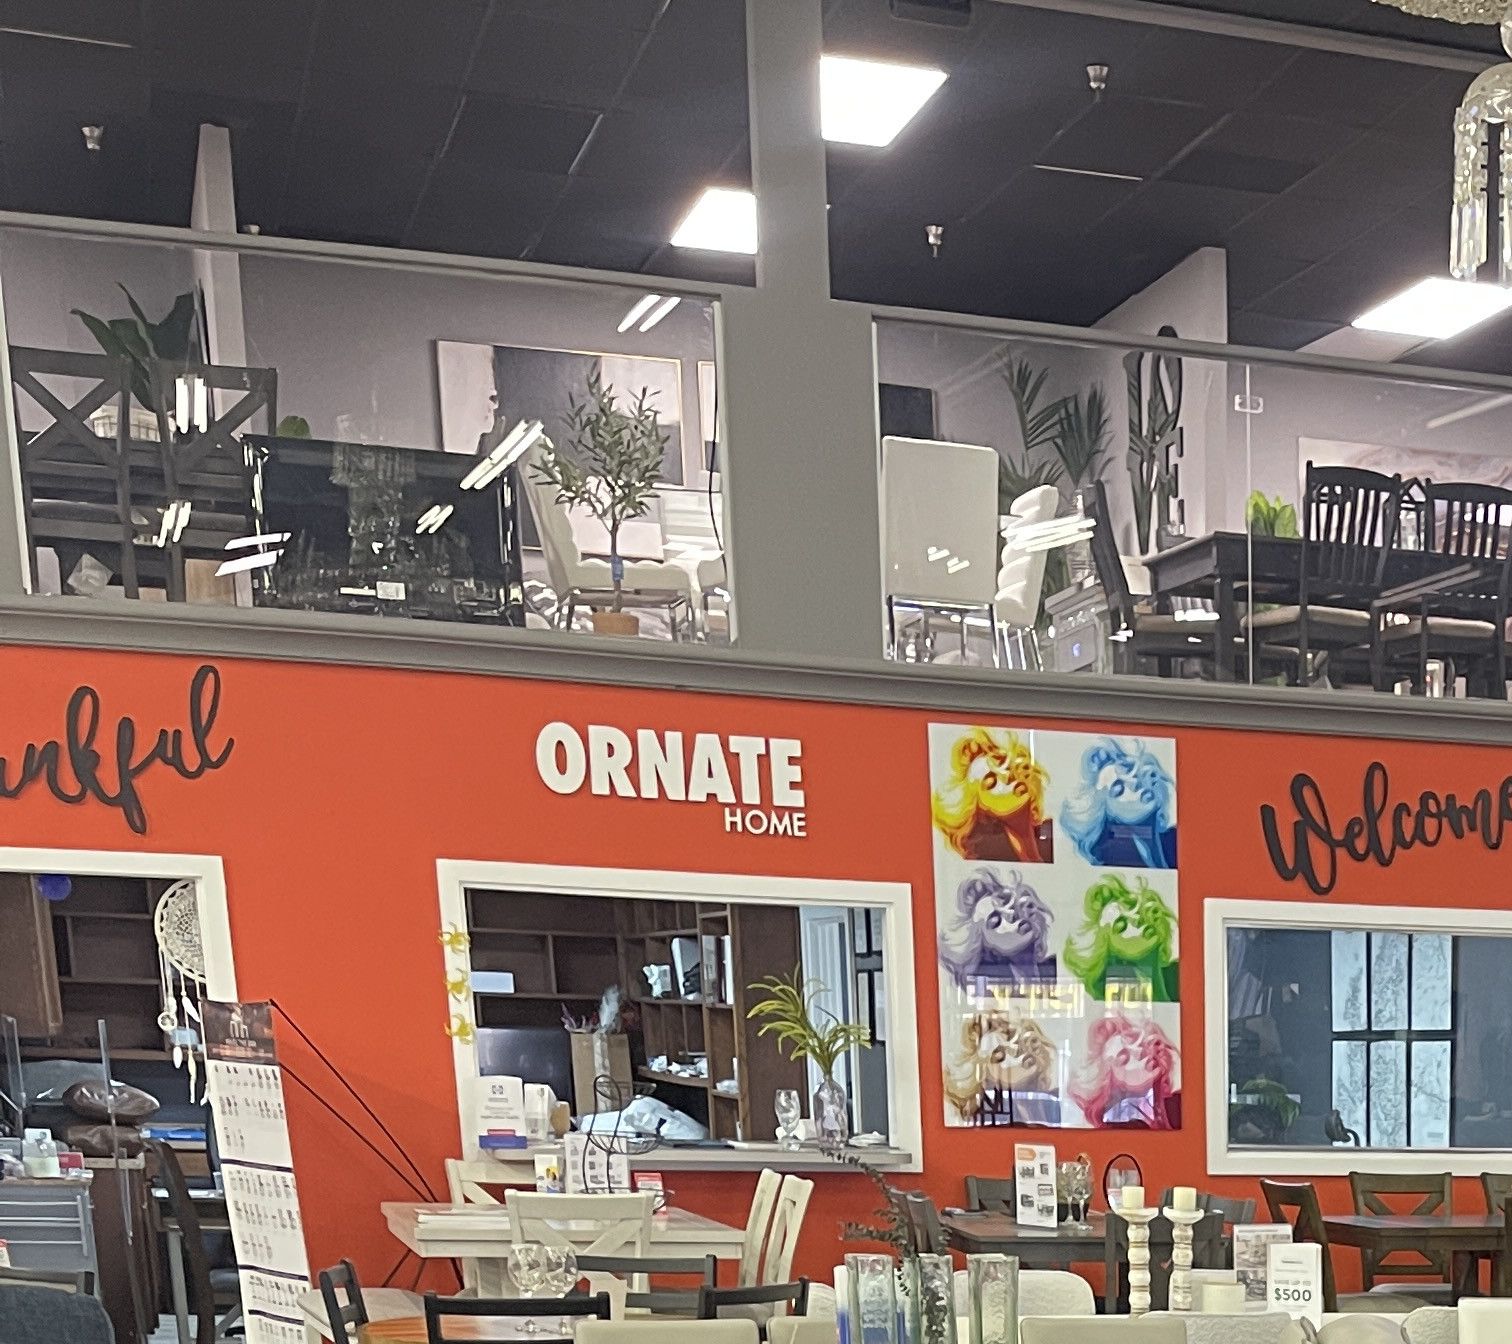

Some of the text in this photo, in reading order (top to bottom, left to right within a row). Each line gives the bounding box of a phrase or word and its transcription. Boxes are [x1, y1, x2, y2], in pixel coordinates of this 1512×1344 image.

[535, 720, 806, 808] ORNATE
[723, 807, 808, 838] HOME
[1274, 1287, 1312, 1302] $500
